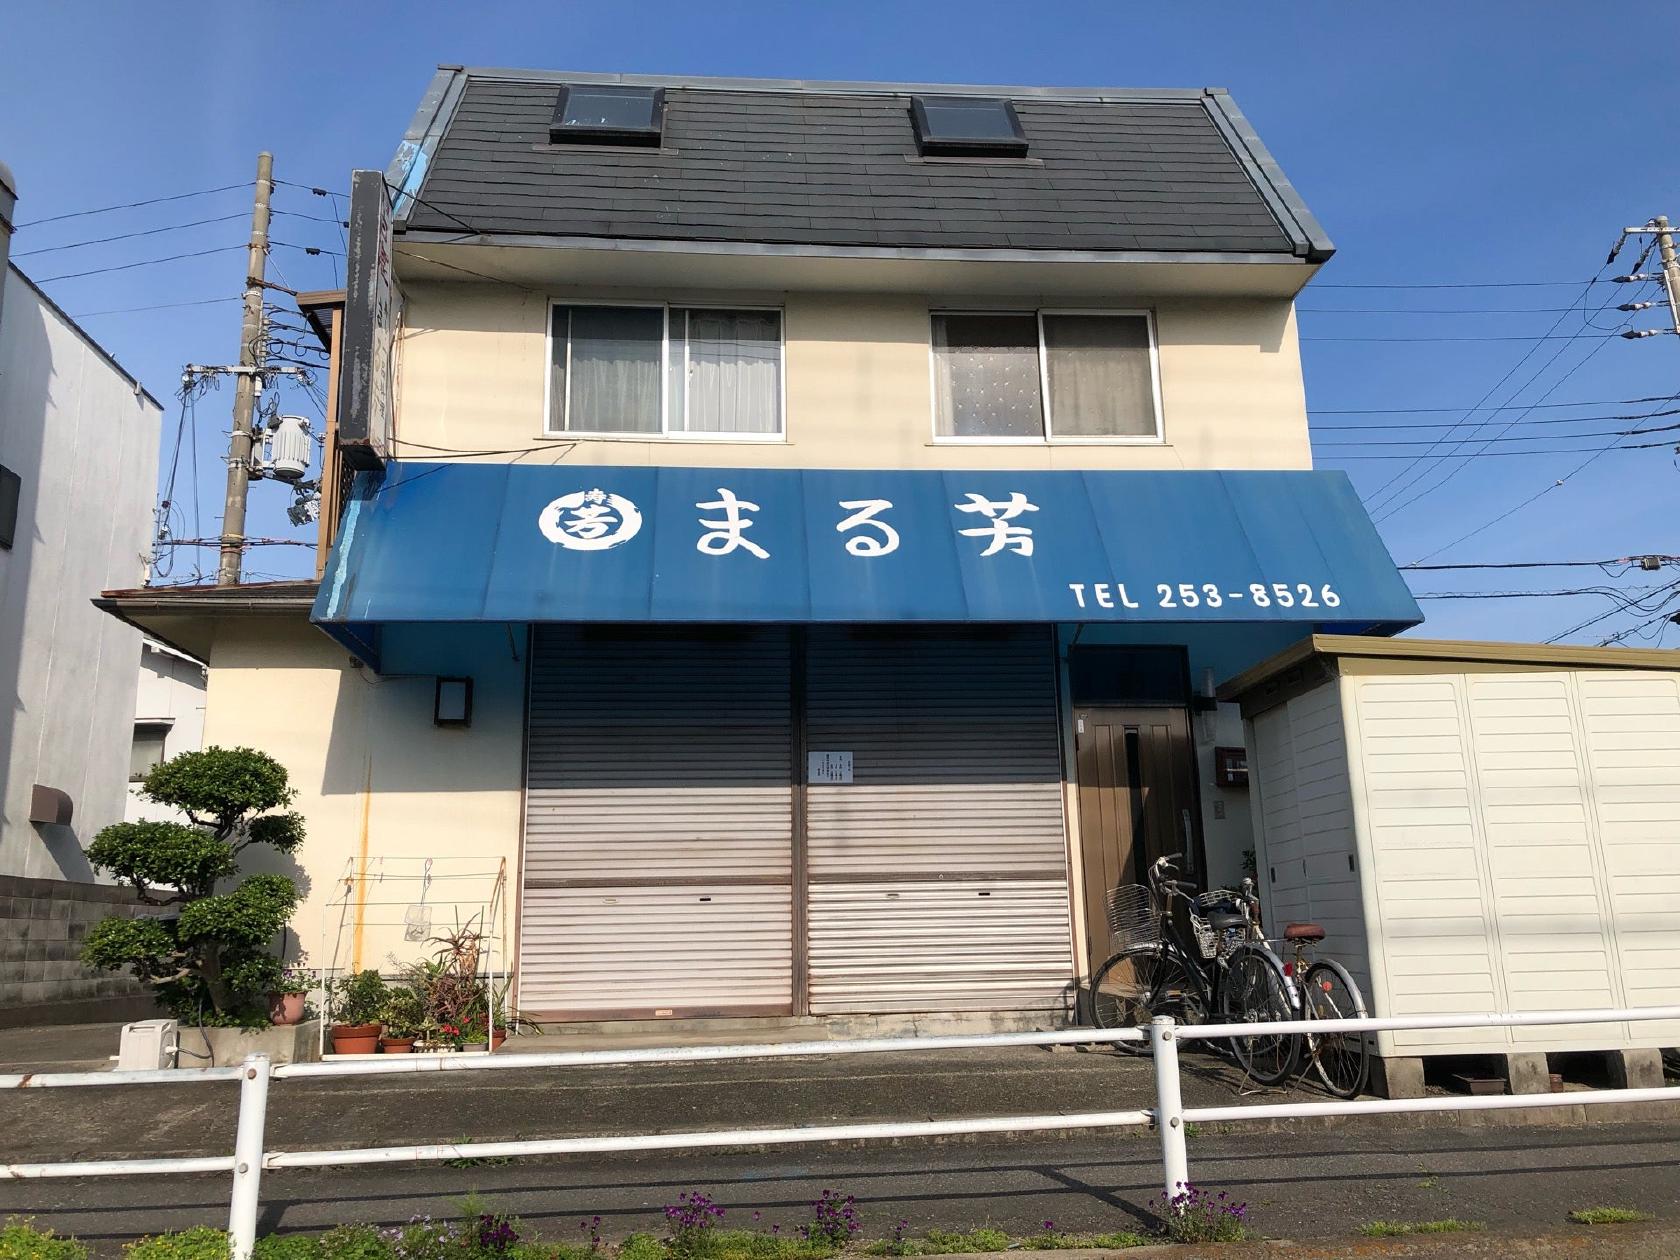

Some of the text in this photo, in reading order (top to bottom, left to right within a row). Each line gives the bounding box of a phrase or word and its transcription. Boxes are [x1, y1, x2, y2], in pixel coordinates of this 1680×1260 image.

[695, 488, 1040, 558] まる芳
[1069, 583, 1341, 608] TEL 253-8526
